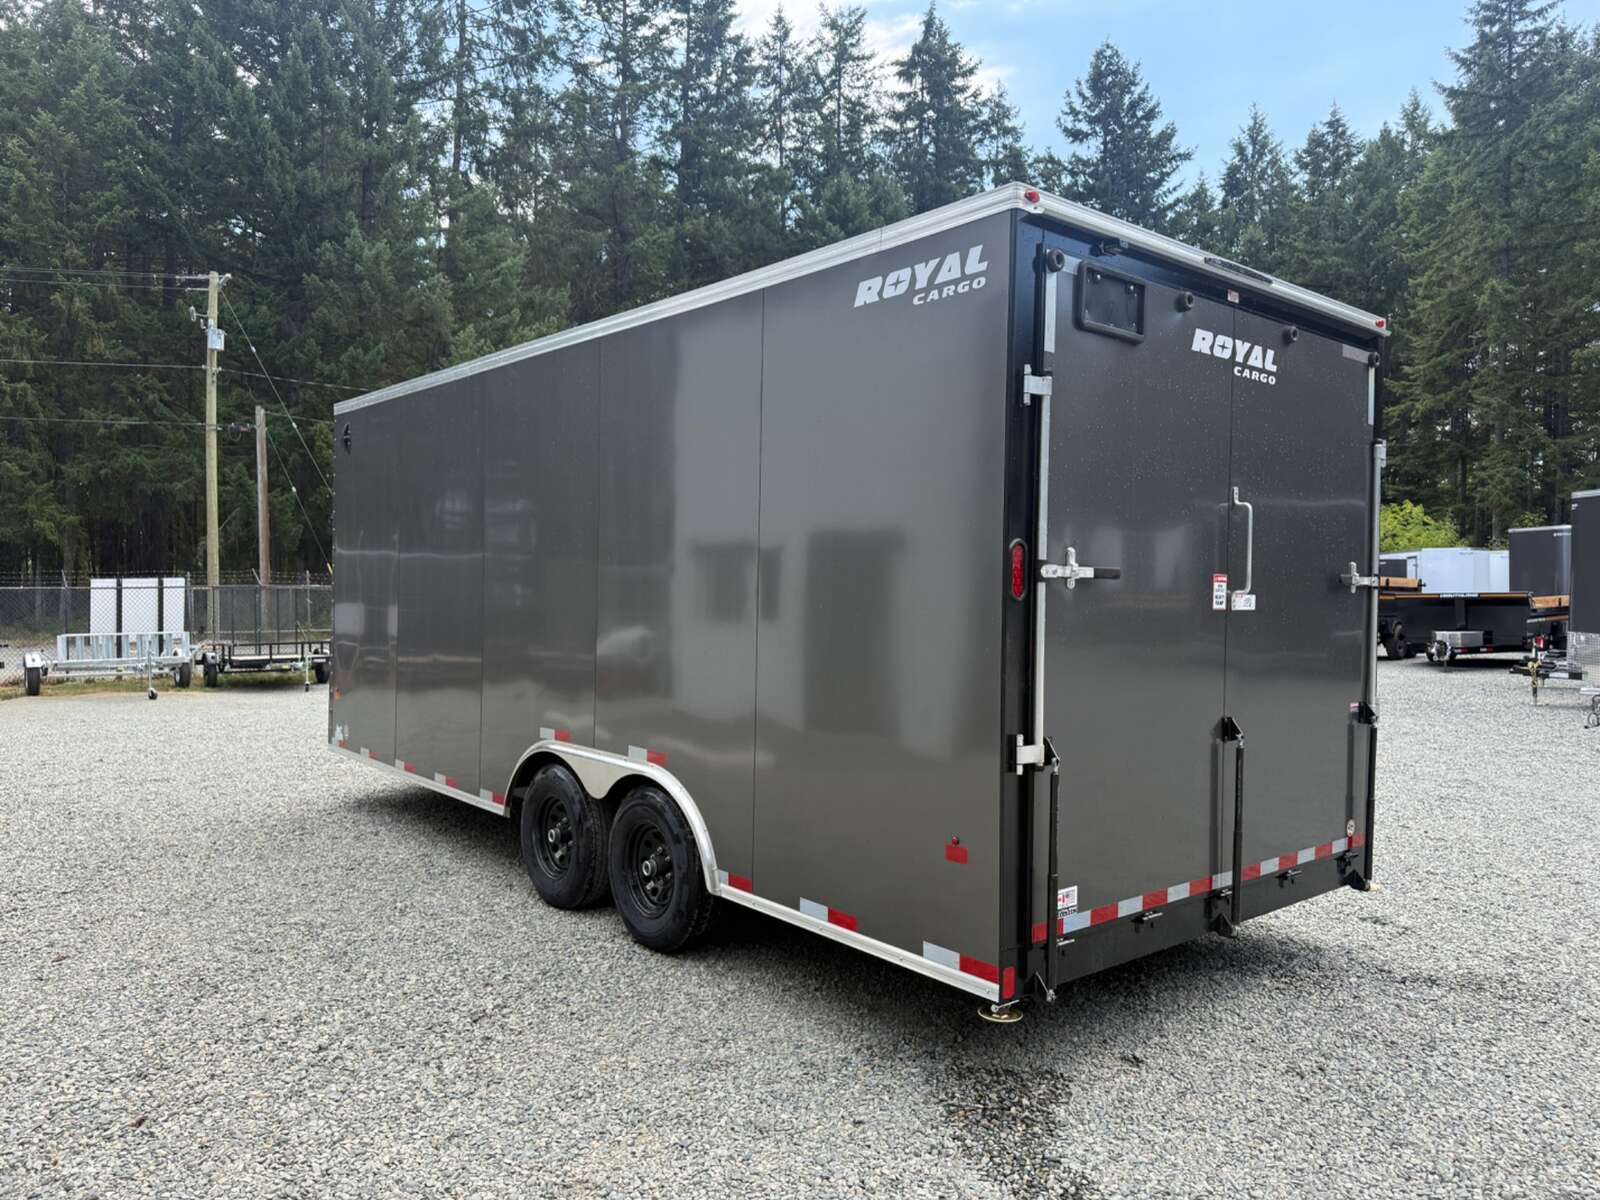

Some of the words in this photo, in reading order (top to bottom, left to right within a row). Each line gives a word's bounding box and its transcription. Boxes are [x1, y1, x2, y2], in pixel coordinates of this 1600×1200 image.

[854, 244, 988, 308] ROYAL
[912, 276, 987, 305] CARGO
[1191, 328, 1278, 373] ROYAL
[1233, 366, 1276, 385] CARGO
